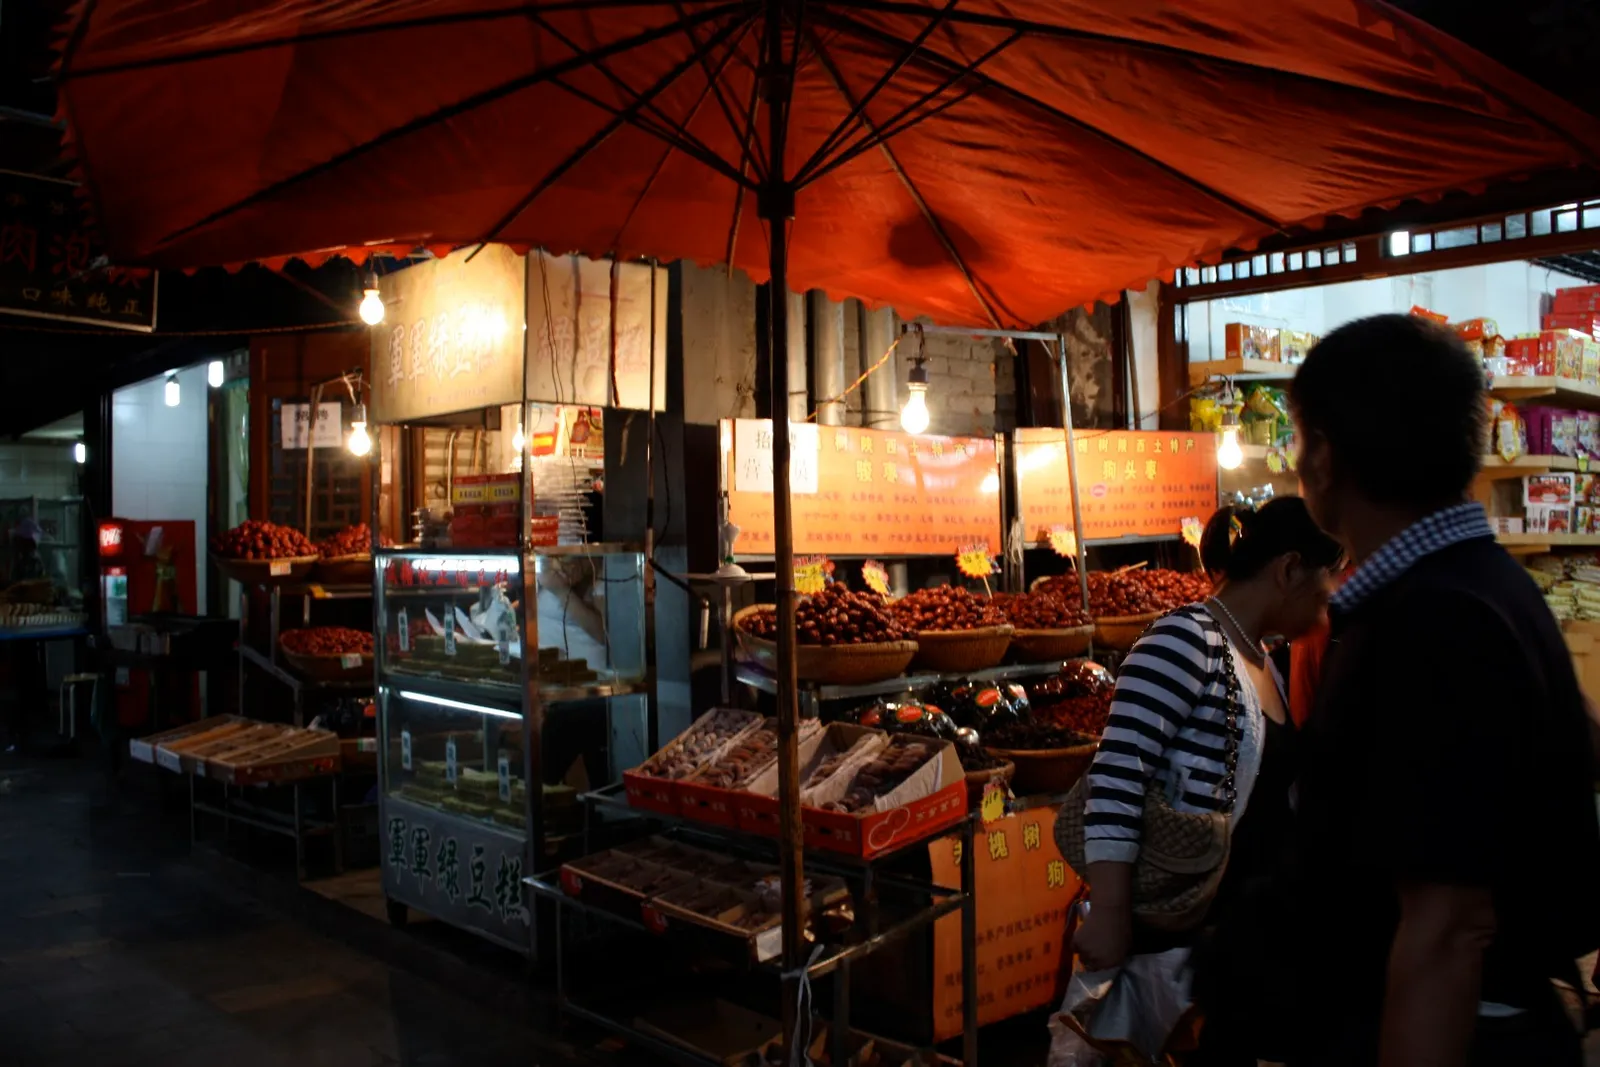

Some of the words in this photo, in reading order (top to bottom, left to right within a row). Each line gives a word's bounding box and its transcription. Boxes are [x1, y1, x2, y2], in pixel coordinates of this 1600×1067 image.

[21, 285, 143, 317] 口味纯正
[817, 431, 969, 459] 树陕西土特产
[743, 458, 808, 480] 营员
[1102, 459, 1157, 481] 狗头枣
